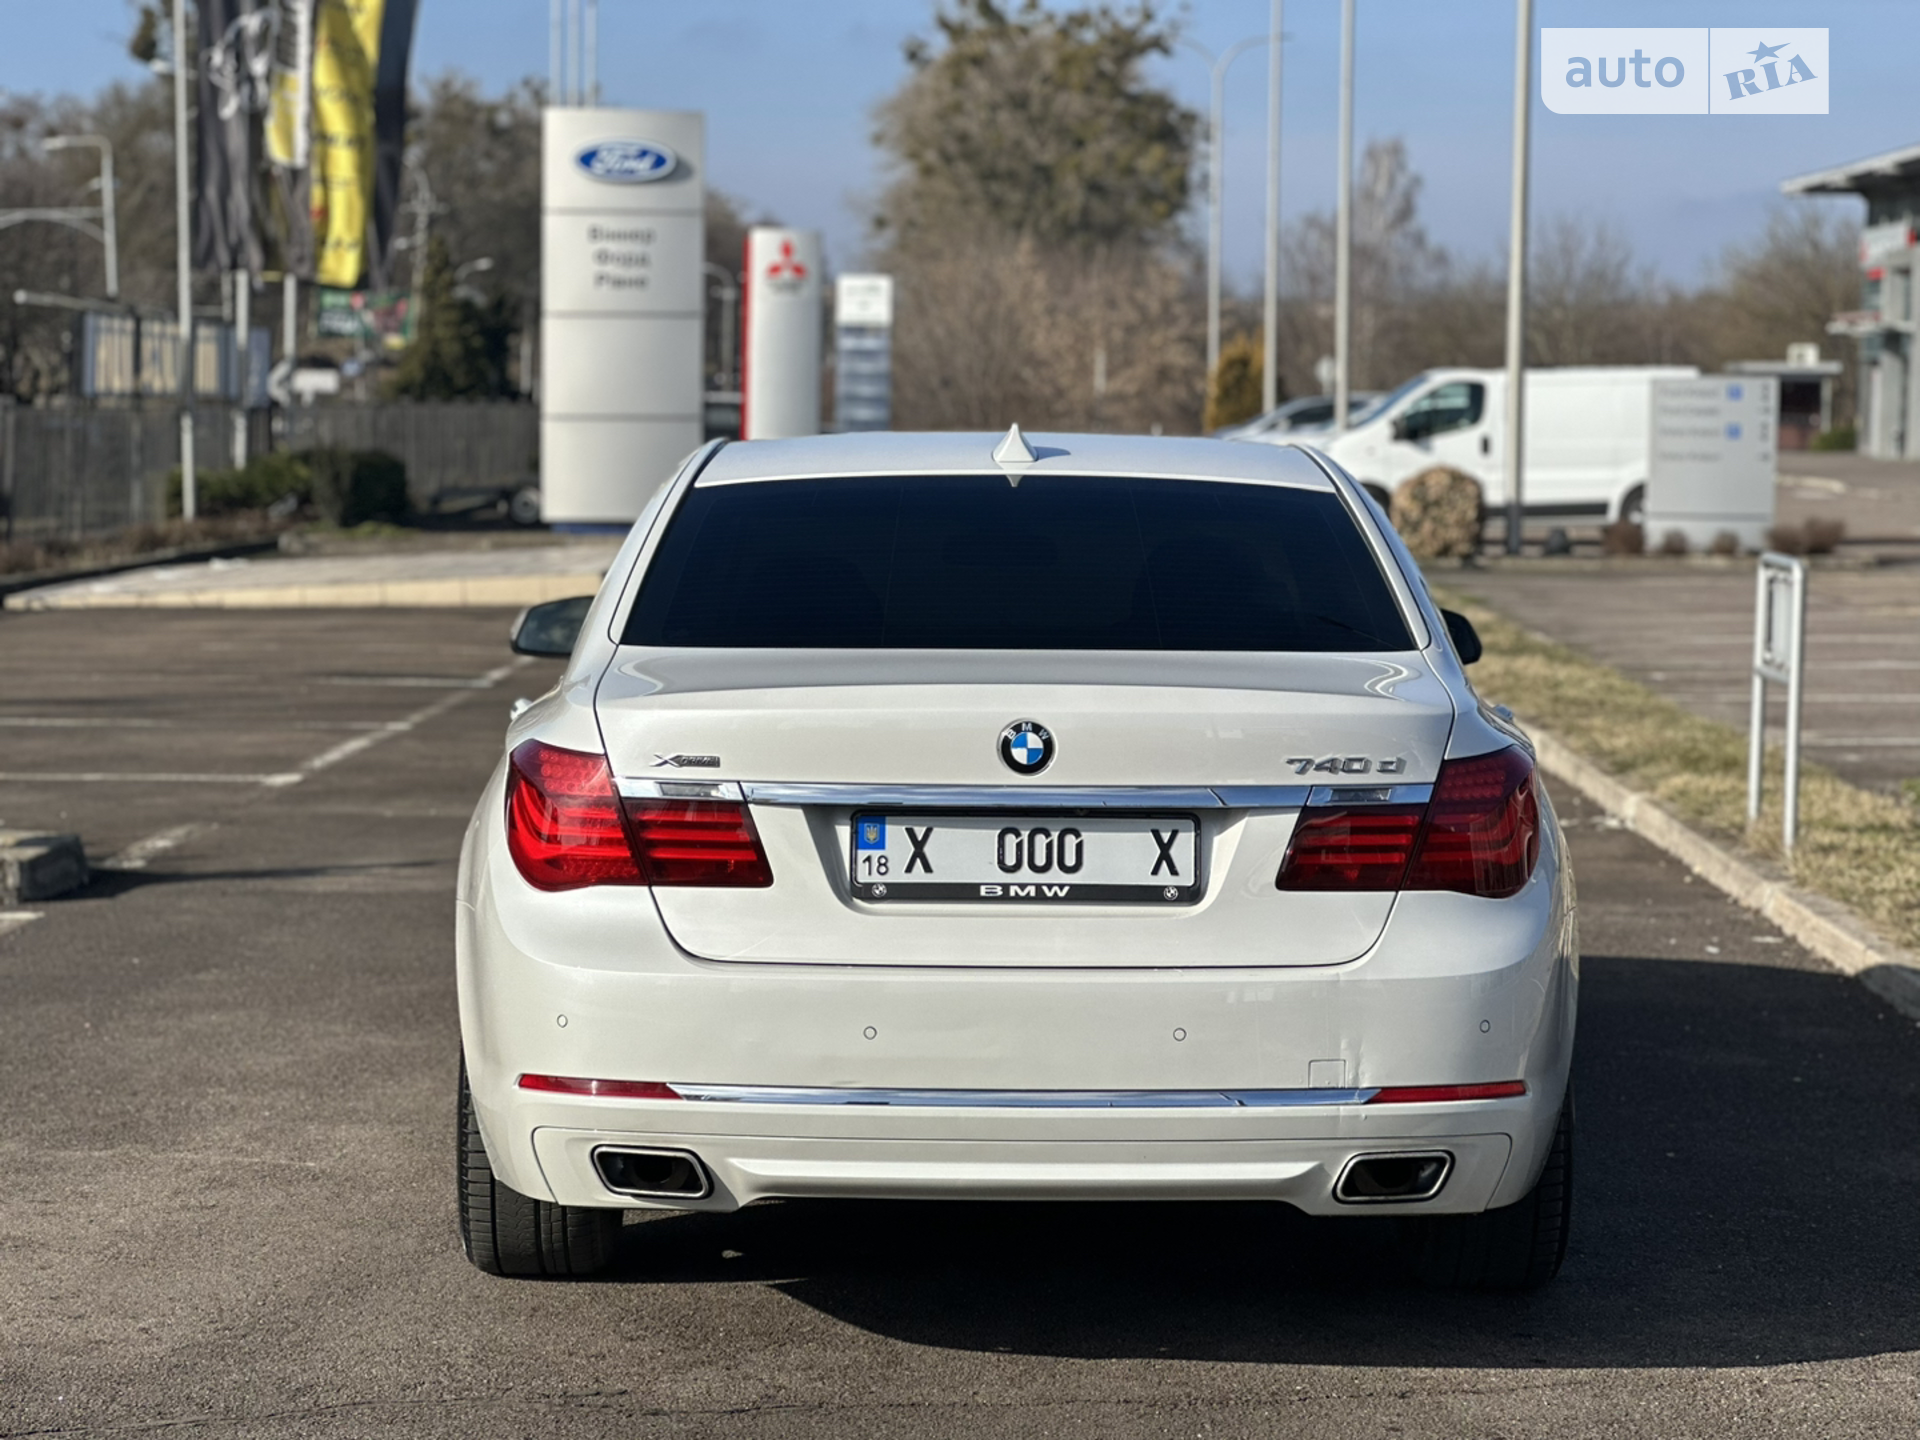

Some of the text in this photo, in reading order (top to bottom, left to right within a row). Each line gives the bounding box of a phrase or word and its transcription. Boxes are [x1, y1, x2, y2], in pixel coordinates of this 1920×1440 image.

[1005, 722, 1051, 740] BMW
[862, 855, 889, 876] 18
[980, 884, 1070, 897] BMW
